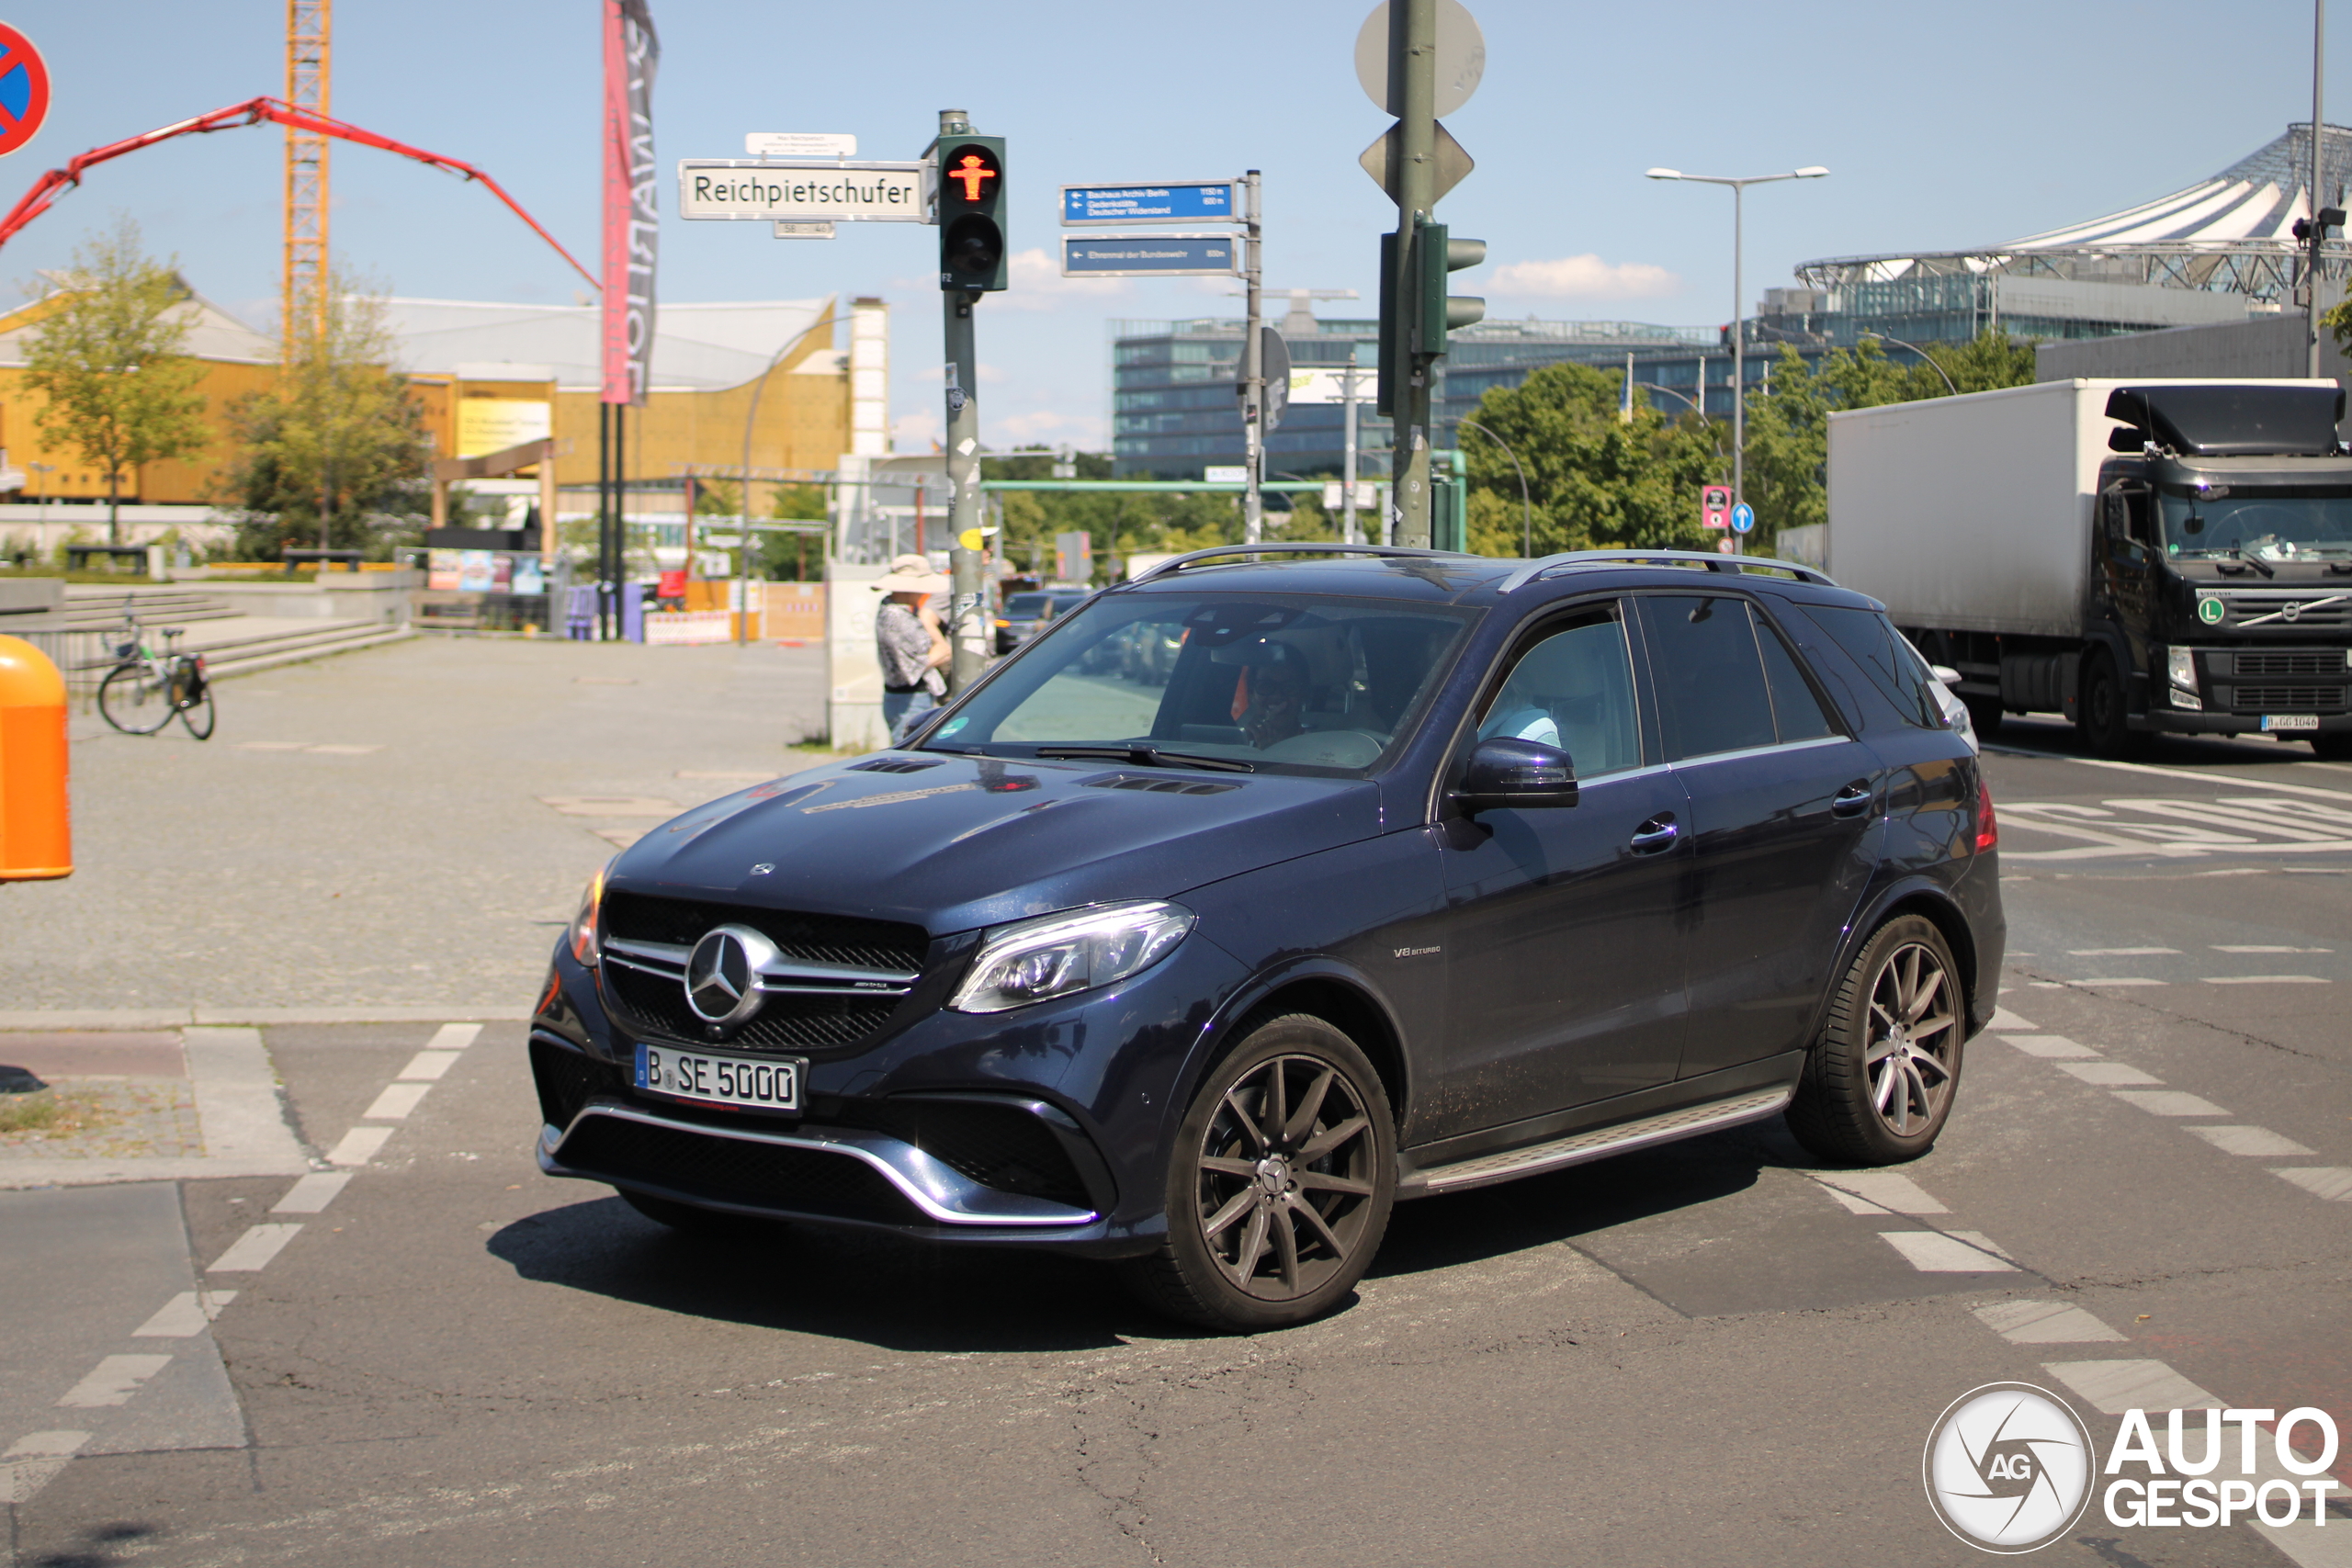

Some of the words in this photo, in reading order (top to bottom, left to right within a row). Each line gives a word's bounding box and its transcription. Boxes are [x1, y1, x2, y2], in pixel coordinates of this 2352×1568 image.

[695, 175, 913, 209] Reichpietschufer
[1086, 190, 1121, 198] Bauhaus
[1146, 188, 1170, 197] Berlin
[815, 224, 827, 232] 46
[942, 273, 953, 283] F2
[2206, 603, 2217, 620] L
[1393, 947, 1410, 958] V8
[1411, 946, 1441, 955] BITURBO
[649, 1051, 662, 1086] B
[678, 1055, 711, 1095] SE
[718, 1062, 794, 1103] 5000
